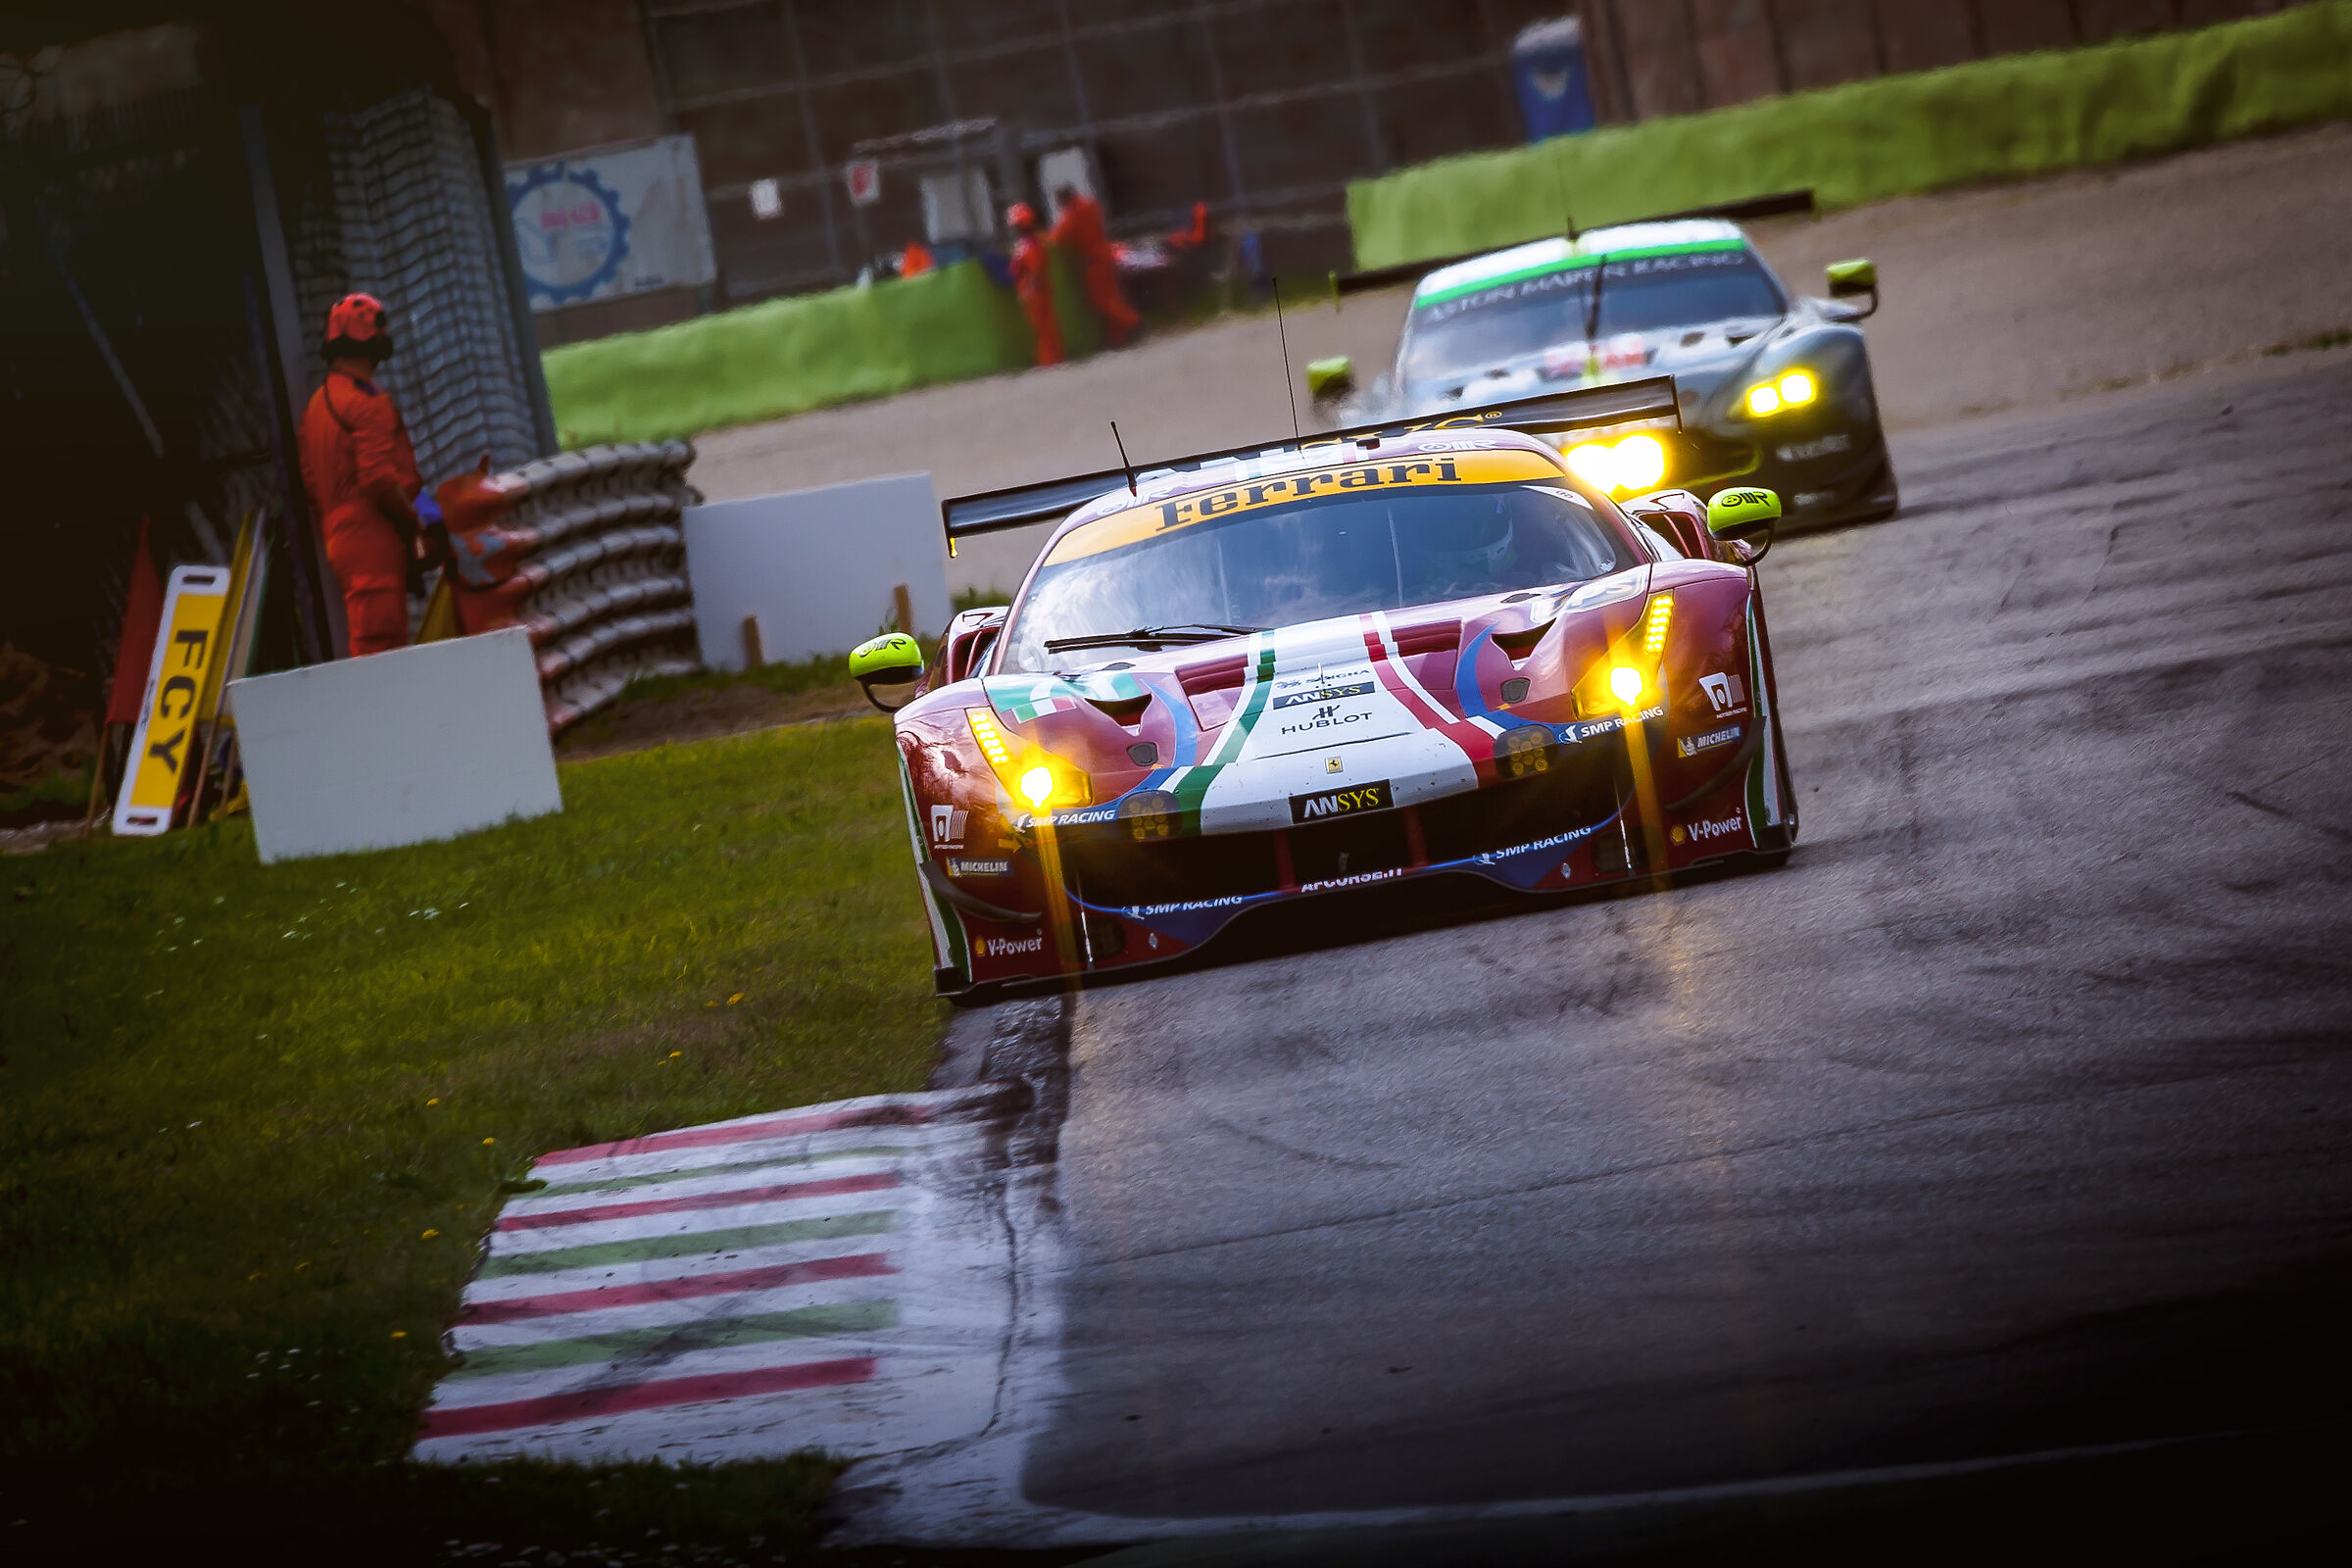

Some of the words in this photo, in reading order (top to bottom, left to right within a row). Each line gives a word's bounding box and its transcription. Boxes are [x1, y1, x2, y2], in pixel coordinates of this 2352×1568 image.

[1519, 264, 1627, 296] MARTN
[1154, 457, 1462, 532] Ferrari
[148, 629, 209, 774] FCY
[1285, 686, 1362, 706] ANSYS
[1281, 711, 1373, 735] HUBLOT
[1580, 720, 1613, 738] SMP
[1614, 706, 1664, 727] RACING
[1696, 726, 1740, 749] MICHELIN
[1303, 787, 1380, 818] ANSYS
[1025, 815, 1057, 828] SMP
[1058, 809, 1116, 825] RACING
[1688, 815, 1741, 842] V-Power
[960, 860, 1008, 873] MICHELIN
[987, 937, 1043, 956] V-Power
